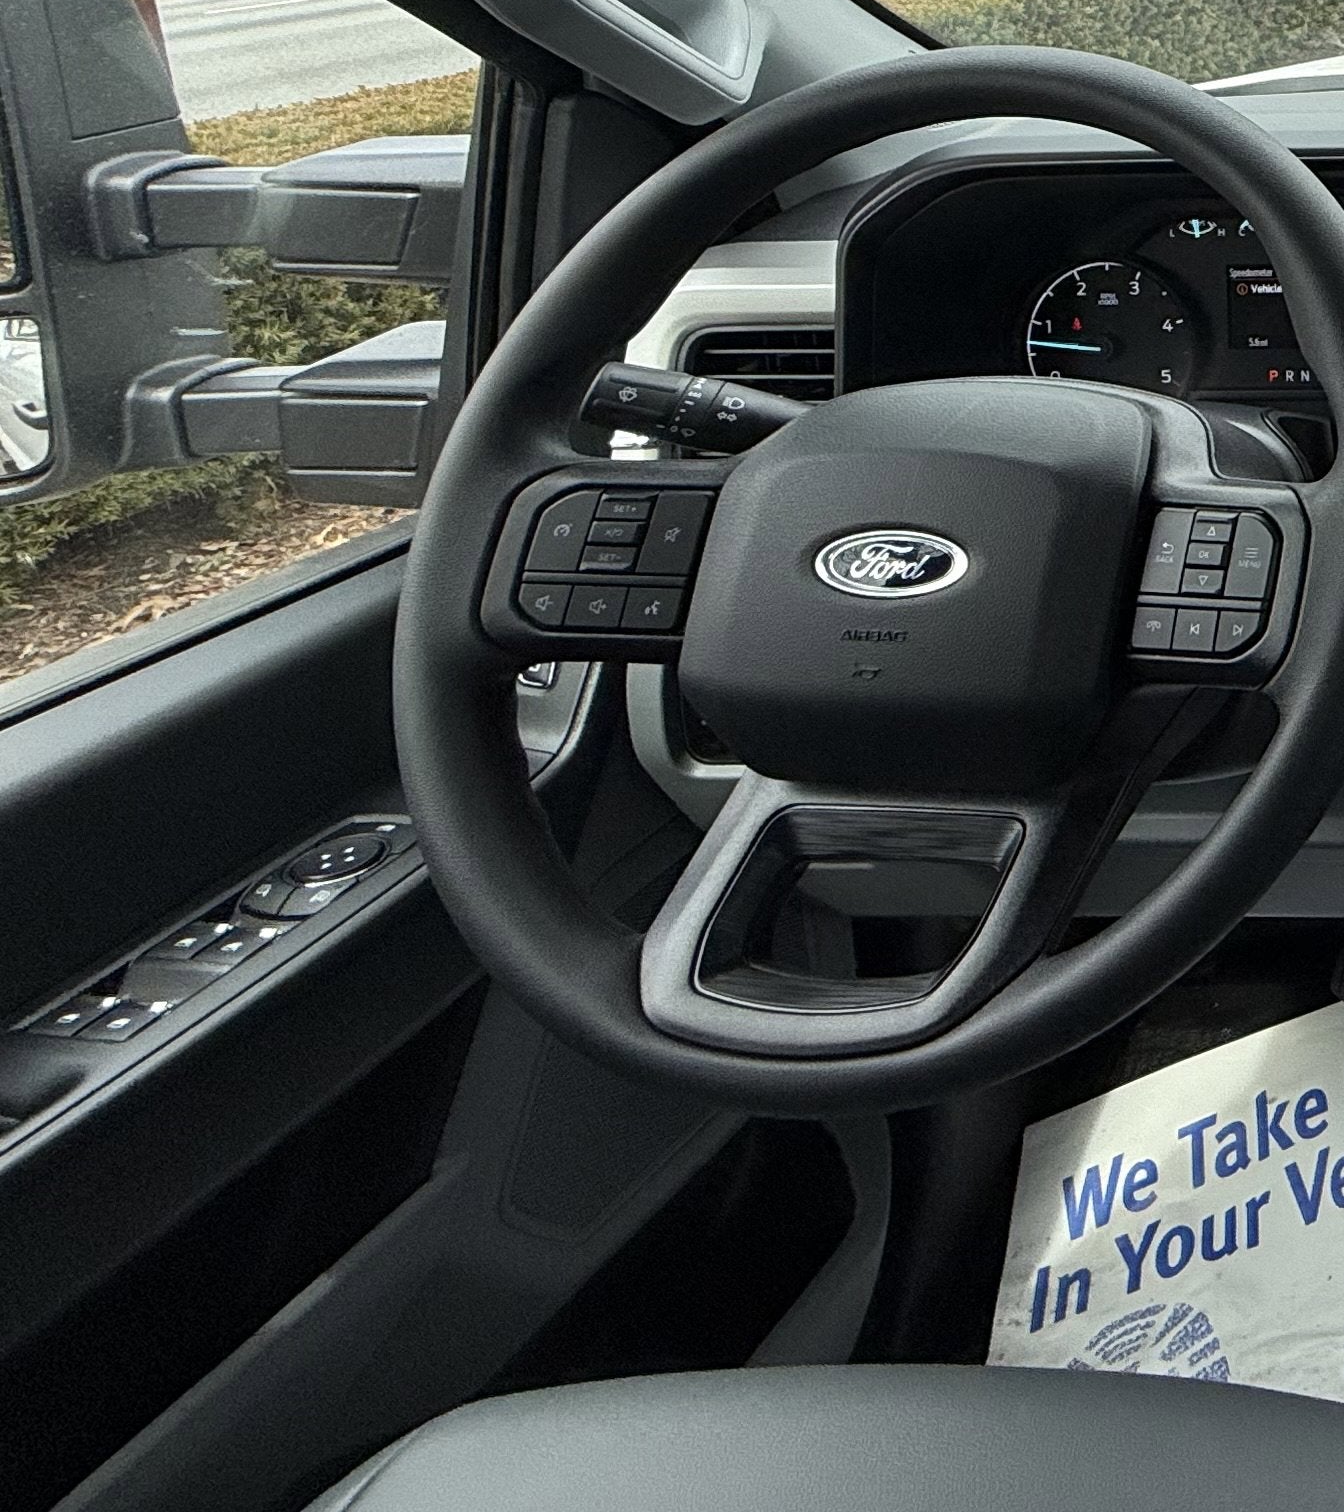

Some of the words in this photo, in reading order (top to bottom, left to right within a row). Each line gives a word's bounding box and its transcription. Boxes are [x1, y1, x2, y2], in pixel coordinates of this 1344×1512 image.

[1169, 229, 1176, 238] L
[1217, 228, 1226, 238] H
[1076, 282, 1087, 296] 2
[1129, 281, 1140, 296] 3
[1045, 319, 1052, 334] 1
[1162, 319, 1174, 333] 4
[1160, 369, 1172, 384] 5
[1269, 370, 1279, 382] P
[1286, 370, 1295, 382] R
[1301, 370, 1311, 382] N
[849, 542, 932, 580] Ford
[841, 629, 910, 642] AIRBAG
[1062, 1152, 1159, 1241] We
[1177, 1088, 1329, 1190] Take
[1028, 1262, 1092, 1334] In
[1114, 1190, 1272, 1295] Your
